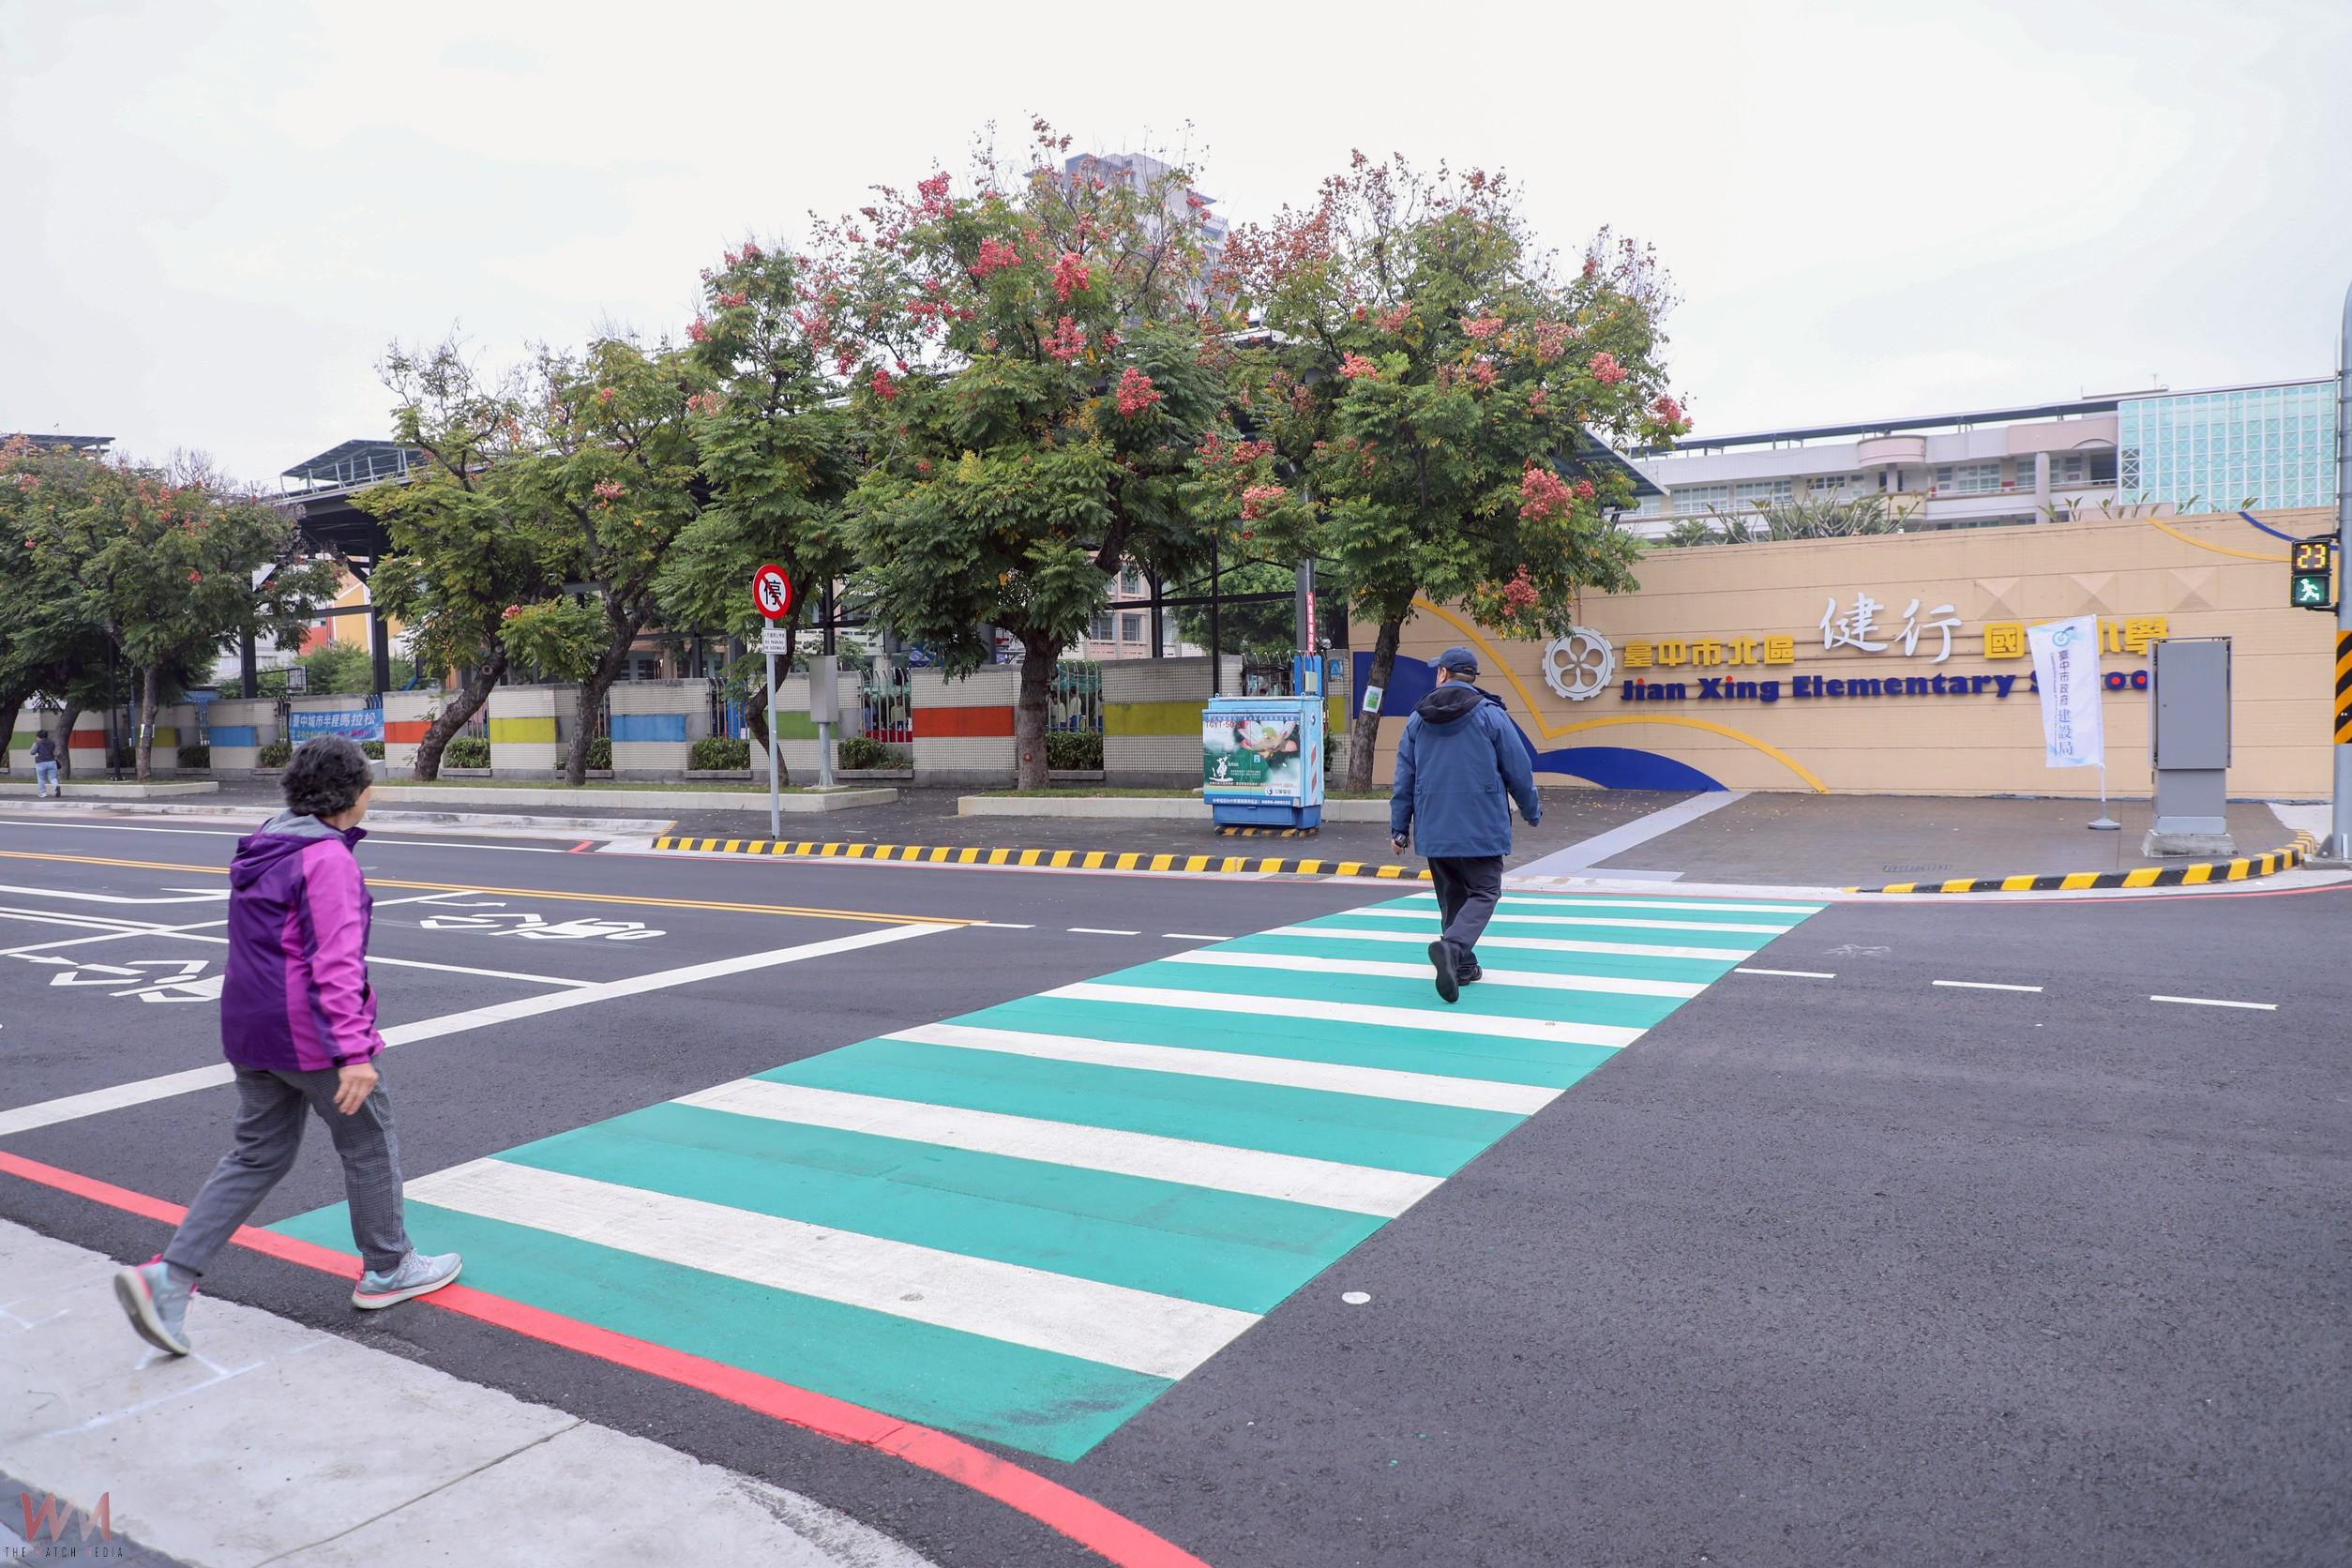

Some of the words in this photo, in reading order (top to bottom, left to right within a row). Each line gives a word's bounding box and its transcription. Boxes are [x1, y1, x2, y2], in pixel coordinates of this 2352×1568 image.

[2297, 544, 2327, 568] 23
[763, 579, 782, 605] 停
[1623, 634, 1795, 668] 臺中市北區
[1819, 592, 1963, 665] 健行
[1983, 615, 2167, 659] 國小學
[1621, 677, 1686, 701] Jian
[1697, 675, 1780, 702] Xing
[1792, 672, 2016, 699] Elementary
